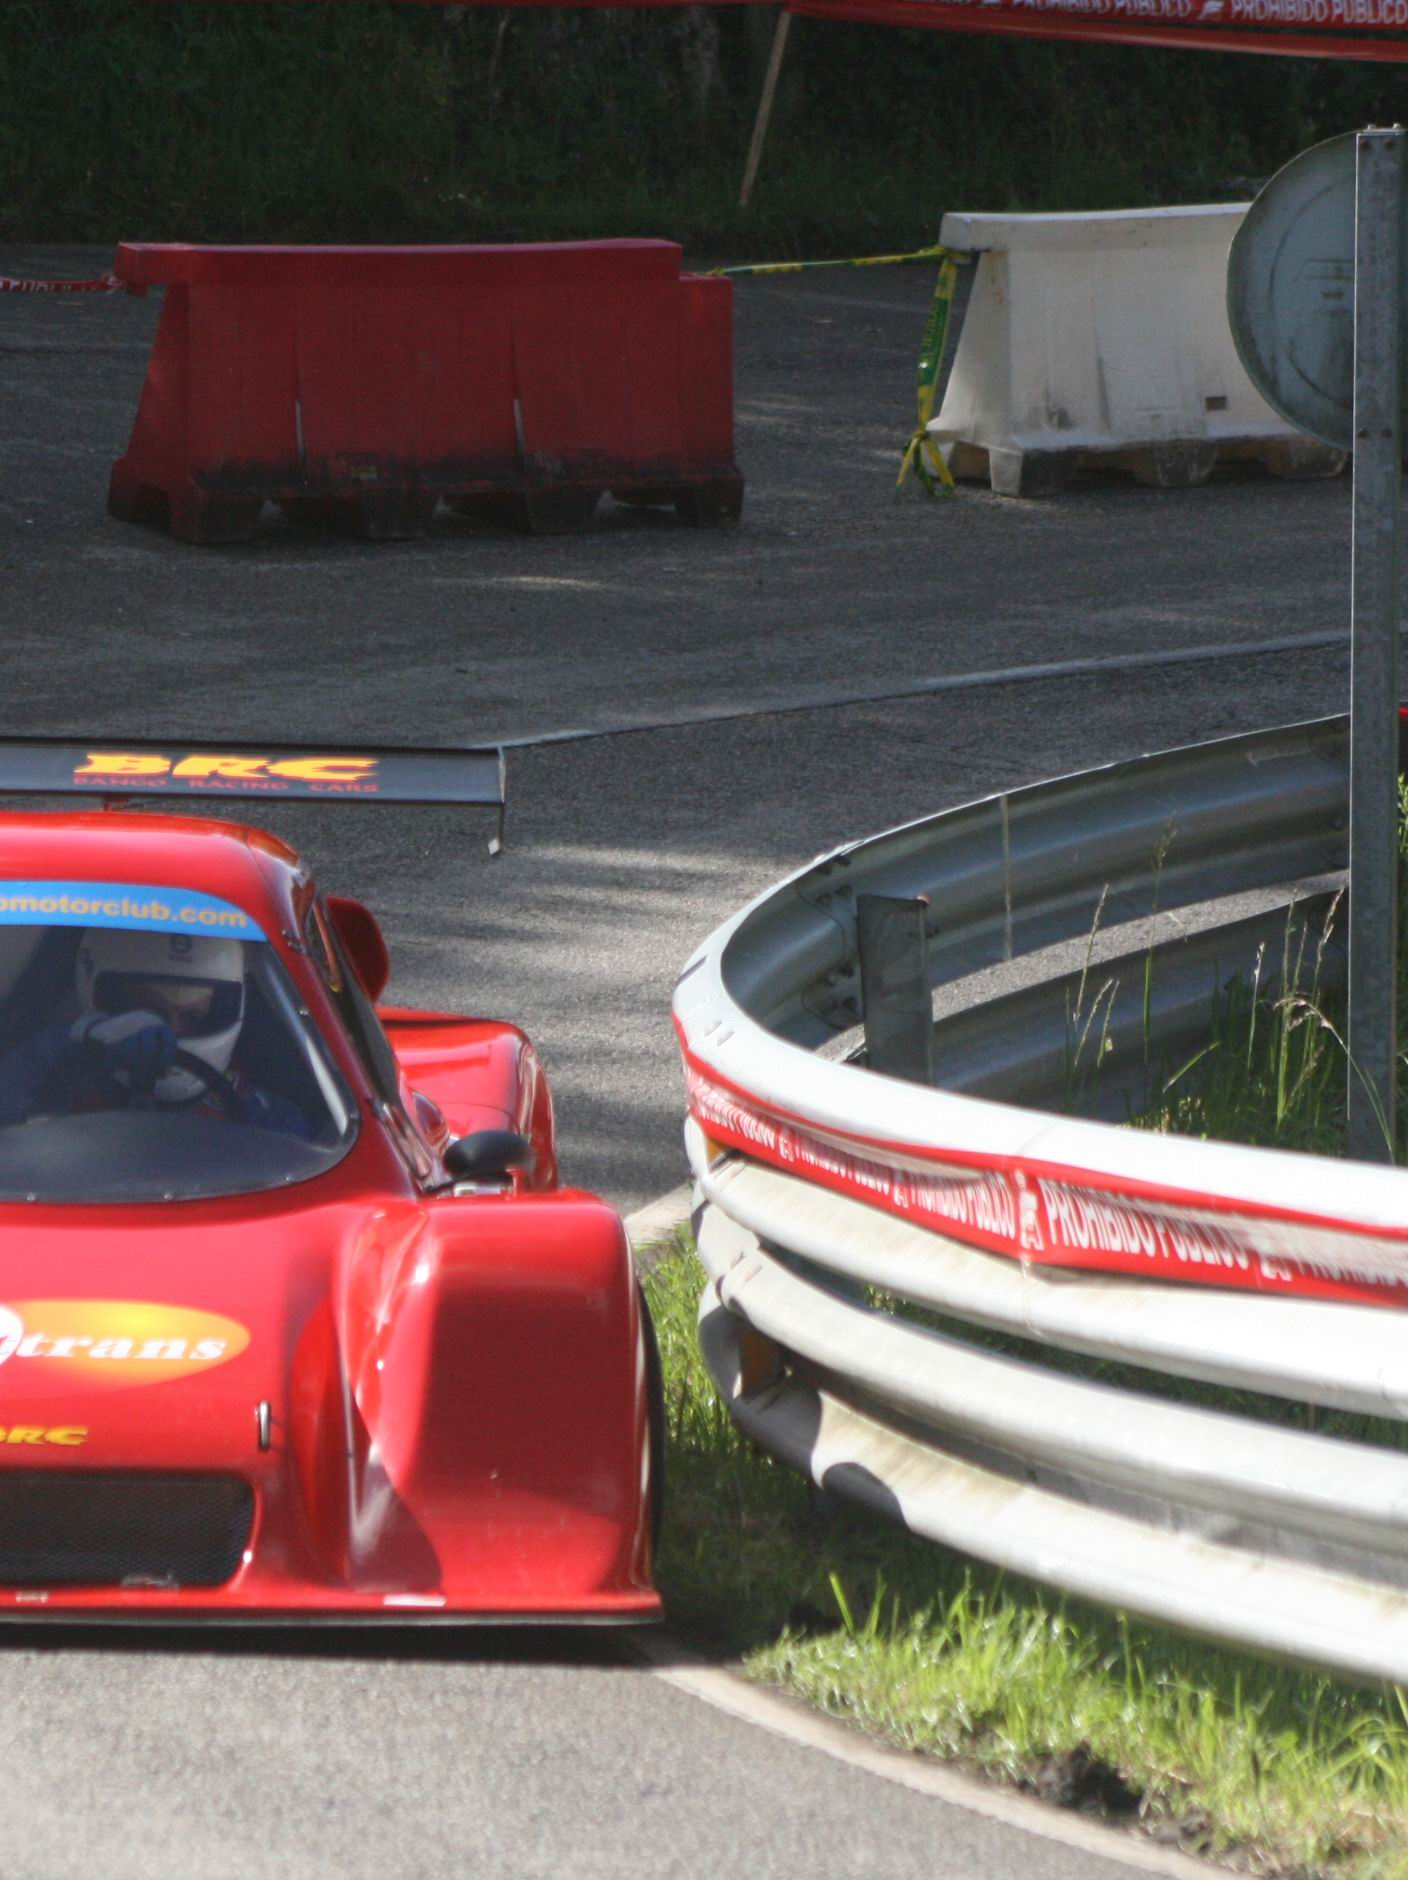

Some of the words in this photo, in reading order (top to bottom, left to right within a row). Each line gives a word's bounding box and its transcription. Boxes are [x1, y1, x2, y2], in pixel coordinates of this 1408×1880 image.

[73, 754, 380, 782] BRC
[188, 779, 289, 790] RACING
[309, 782, 381, 793] CARS
[1038, 1177, 1156, 1258] PROHIBIDO
